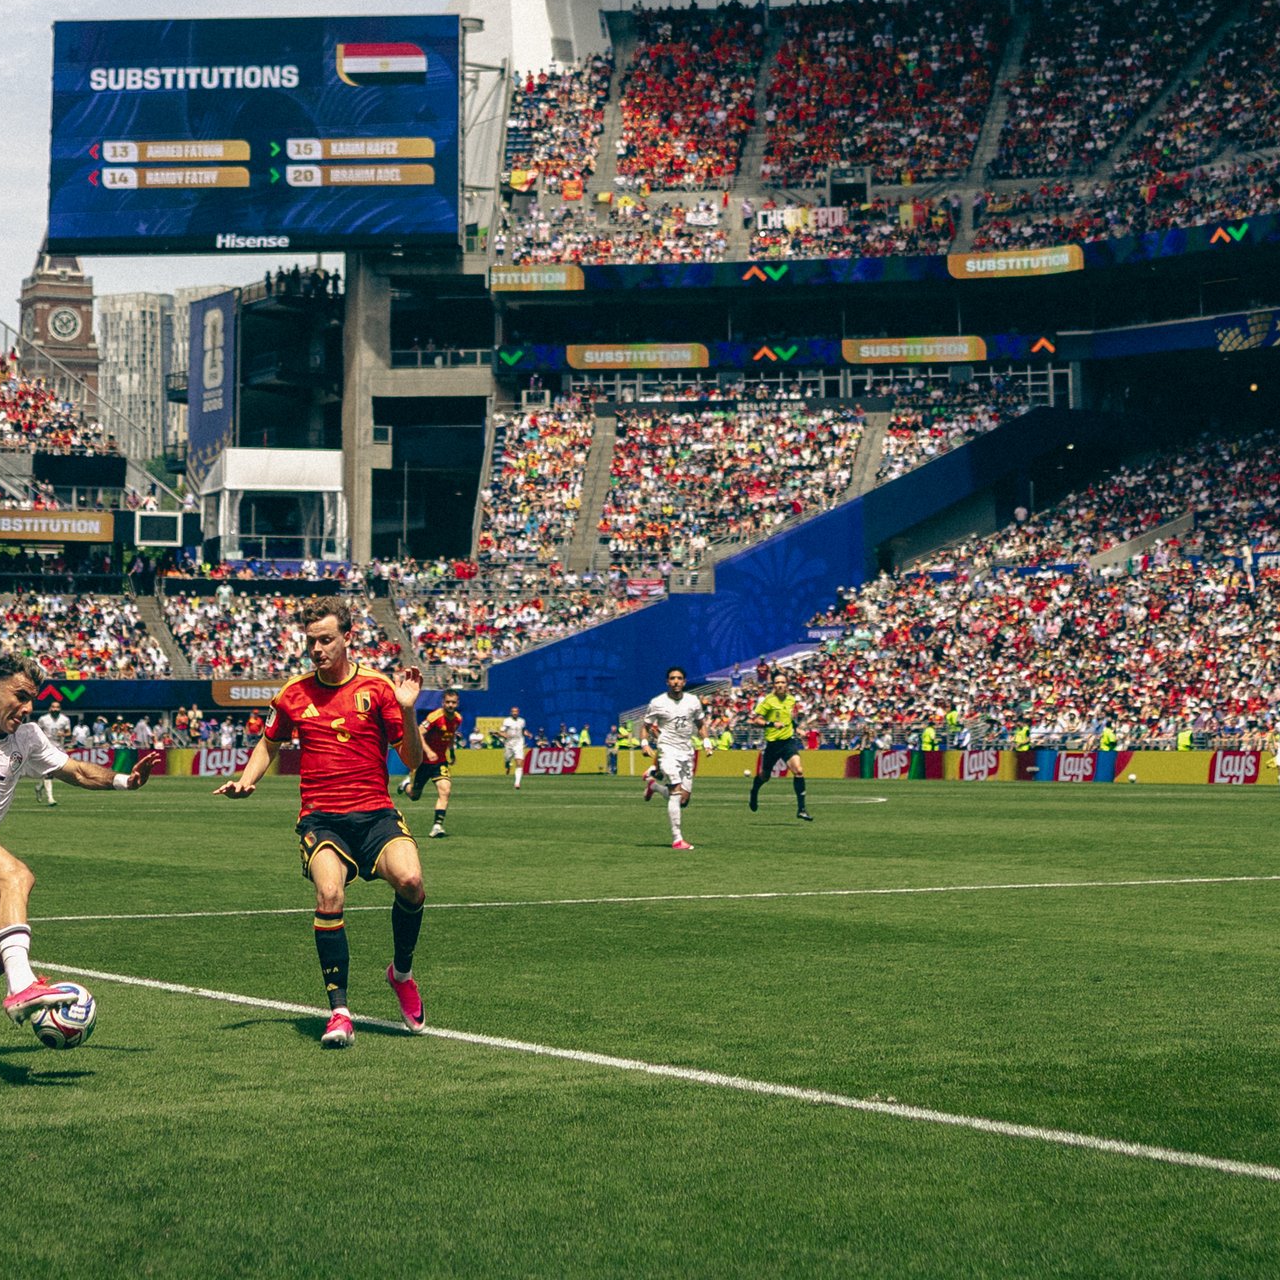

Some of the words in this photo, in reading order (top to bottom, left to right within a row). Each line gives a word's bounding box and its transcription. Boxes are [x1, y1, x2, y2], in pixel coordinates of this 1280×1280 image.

[90, 65, 299, 91] SUBSTITUTIONS
[110, 145, 129, 158] 13
[294, 143, 313, 156] 15
[109, 172, 129, 185] 14
[293, 170, 314, 182] 20
[216, 233, 289, 248] Hisense
[965, 253, 1069, 273] SUBSTITUTION
[584, 351, 691, 363] SUBSTITUTION
[860, 343, 968, 358] SUBSTITUTION
[331, 717, 351, 742] 5
[529, 747, 576, 774] Lay's
[1058, 750, 1094, 782] Lay's
[1214, 749, 1256, 784] Lay's
